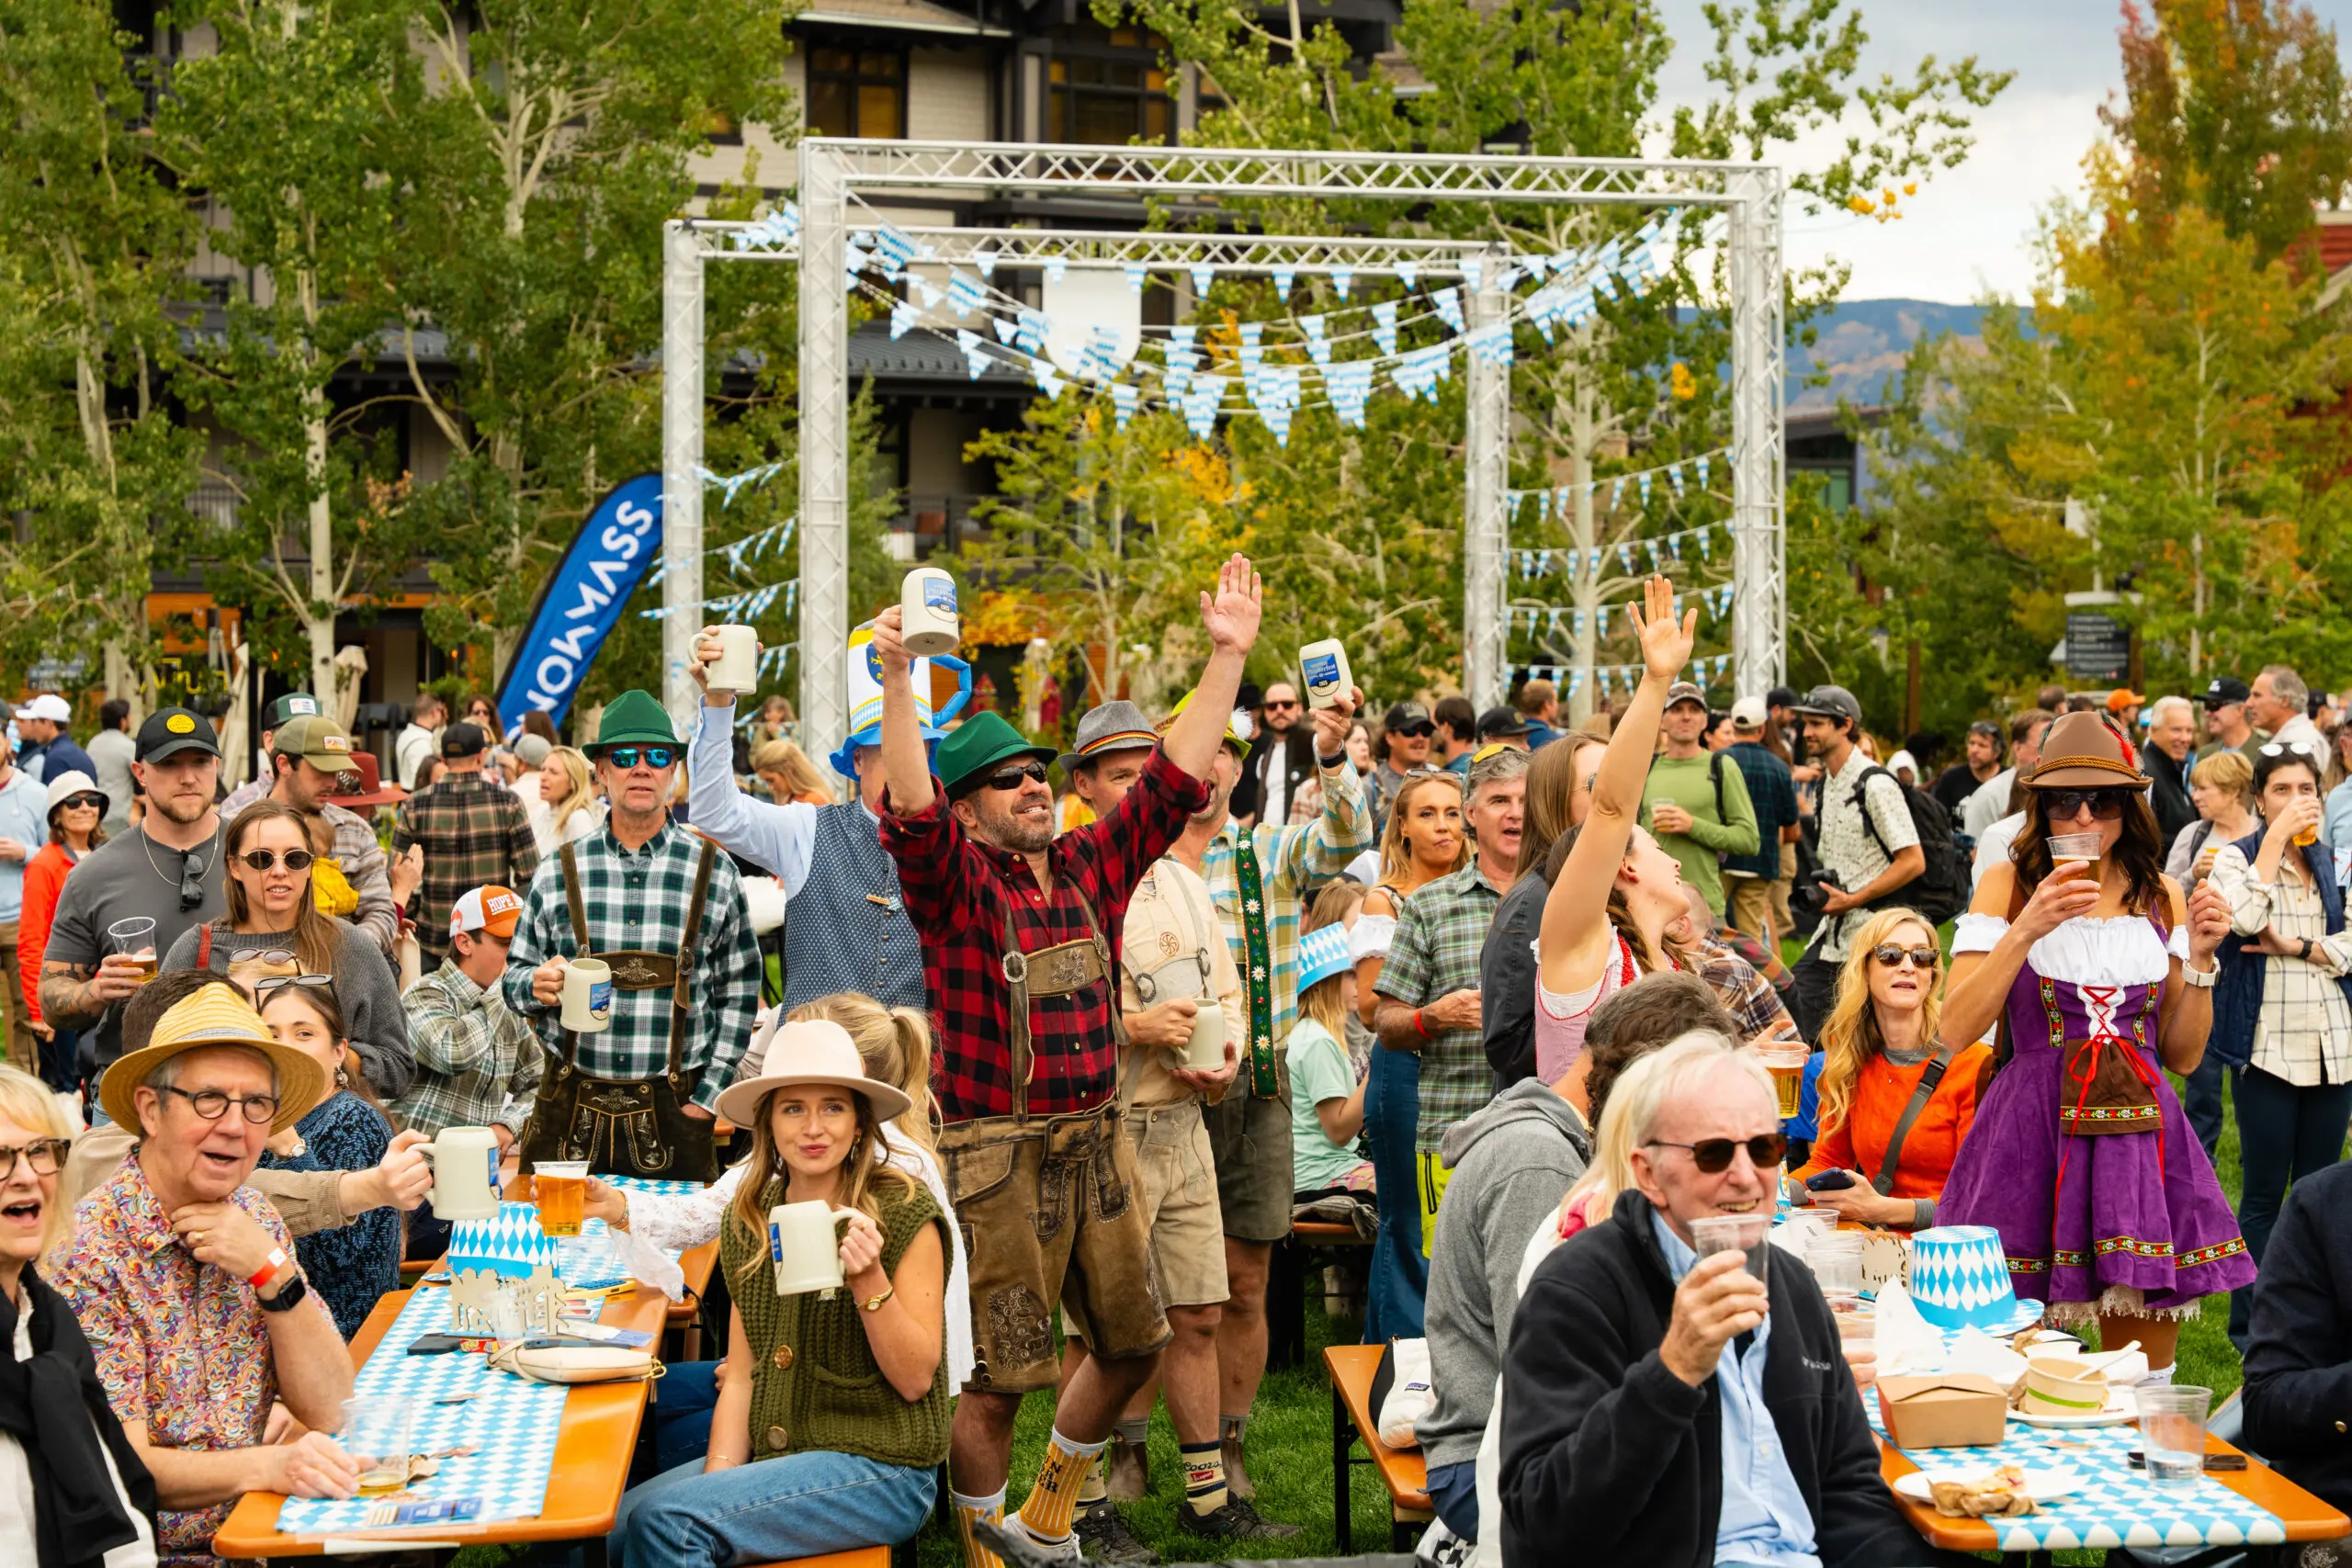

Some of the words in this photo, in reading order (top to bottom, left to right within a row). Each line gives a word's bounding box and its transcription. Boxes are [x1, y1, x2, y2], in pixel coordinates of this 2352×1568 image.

[507, 500, 653, 742] NOWMASS
[486, 894, 514, 913] HOPE
[1183, 1461, 1220, 1472] Coors
